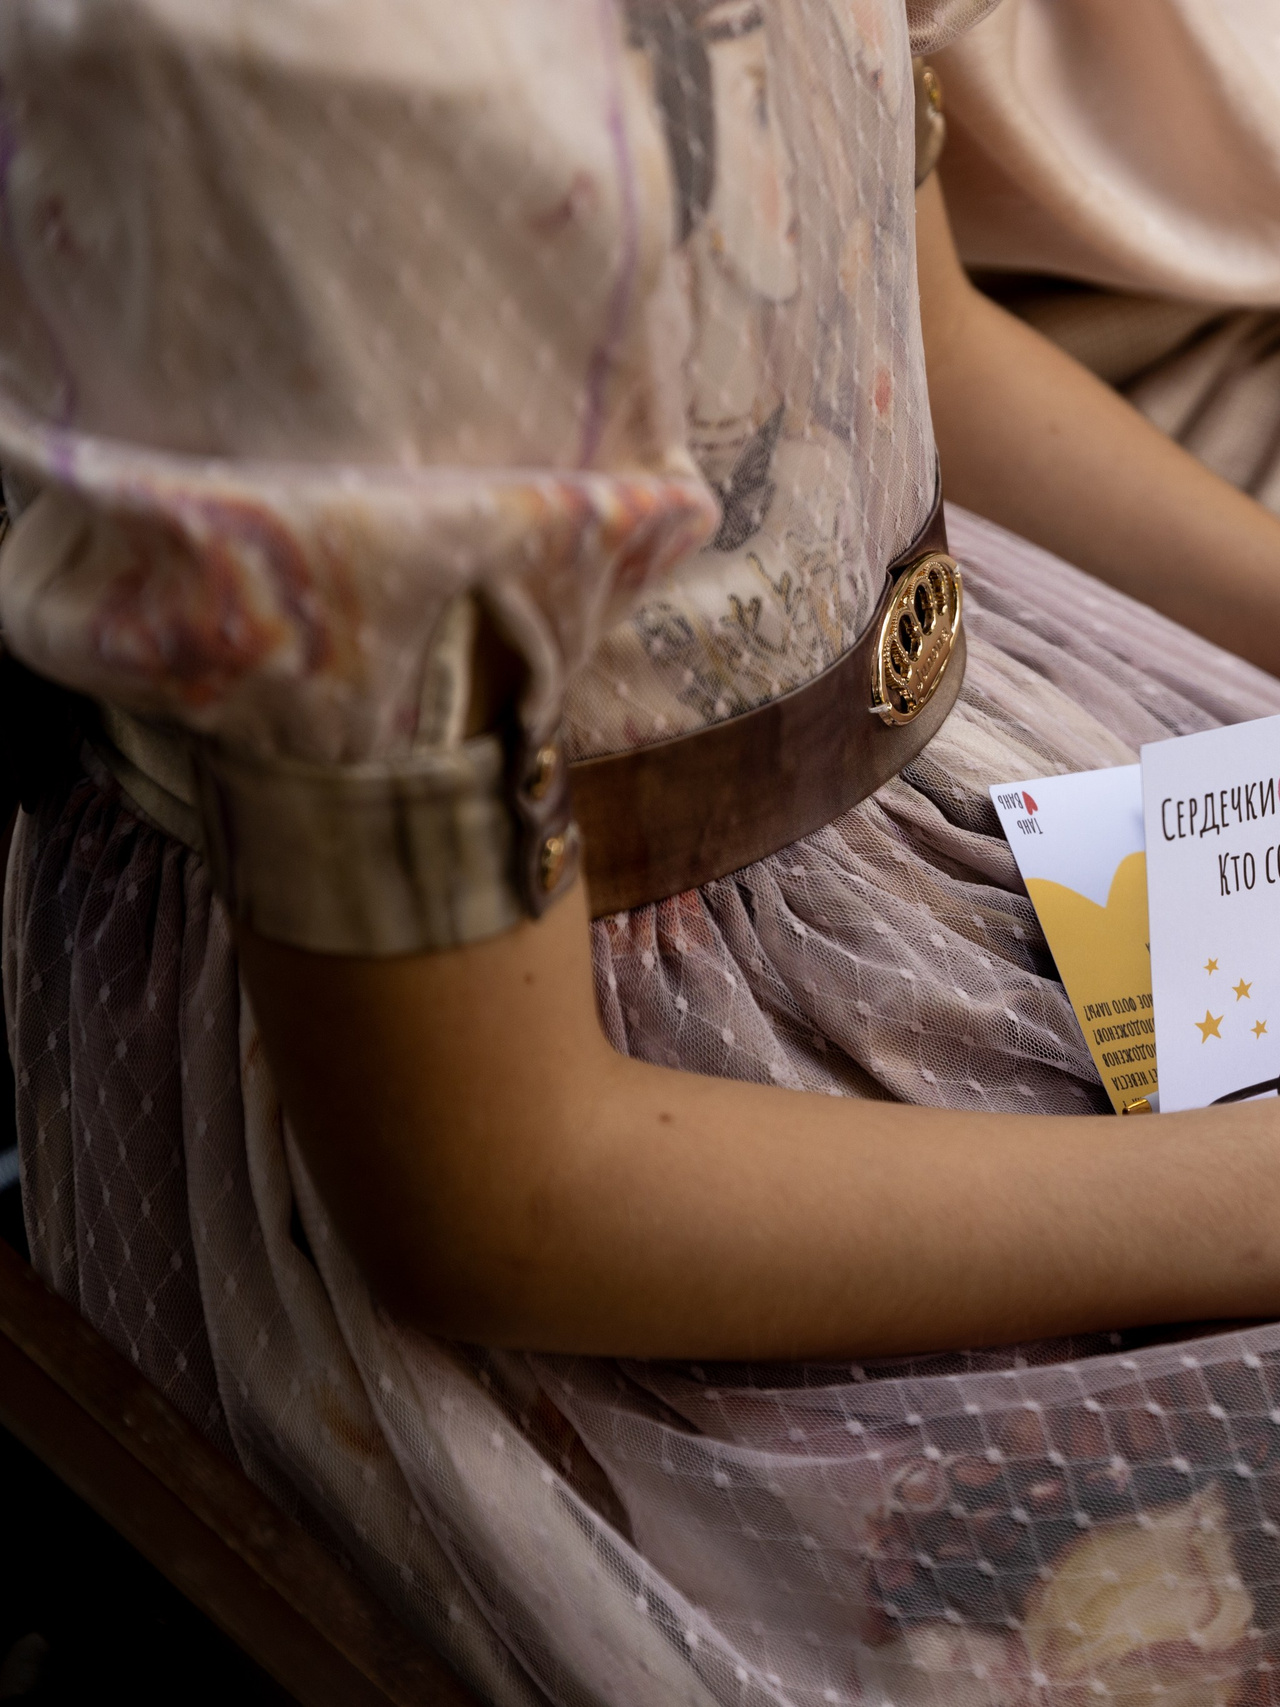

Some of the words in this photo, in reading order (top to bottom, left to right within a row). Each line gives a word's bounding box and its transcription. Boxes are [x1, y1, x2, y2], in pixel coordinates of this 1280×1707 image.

[997, 792, 1024, 810] ВАНЬ
[1161, 777, 1275, 841] СЕРДЕЧКИ
[1016, 817, 1043, 835] ТАНЬ
[1218, 852, 1255, 896] КТО
[1083, 1001, 1112, 1022] ПАРЫ?
[1112, 996, 1137, 1014] ФОТО
[1093, 1017, 1155, 1046] ЛОДОЖЕНОВ?
[1101, 1042, 1156, 1068] ЛОДОЖЕНОВ
[1111, 1071, 1149, 1091] НЕВЕСТА
